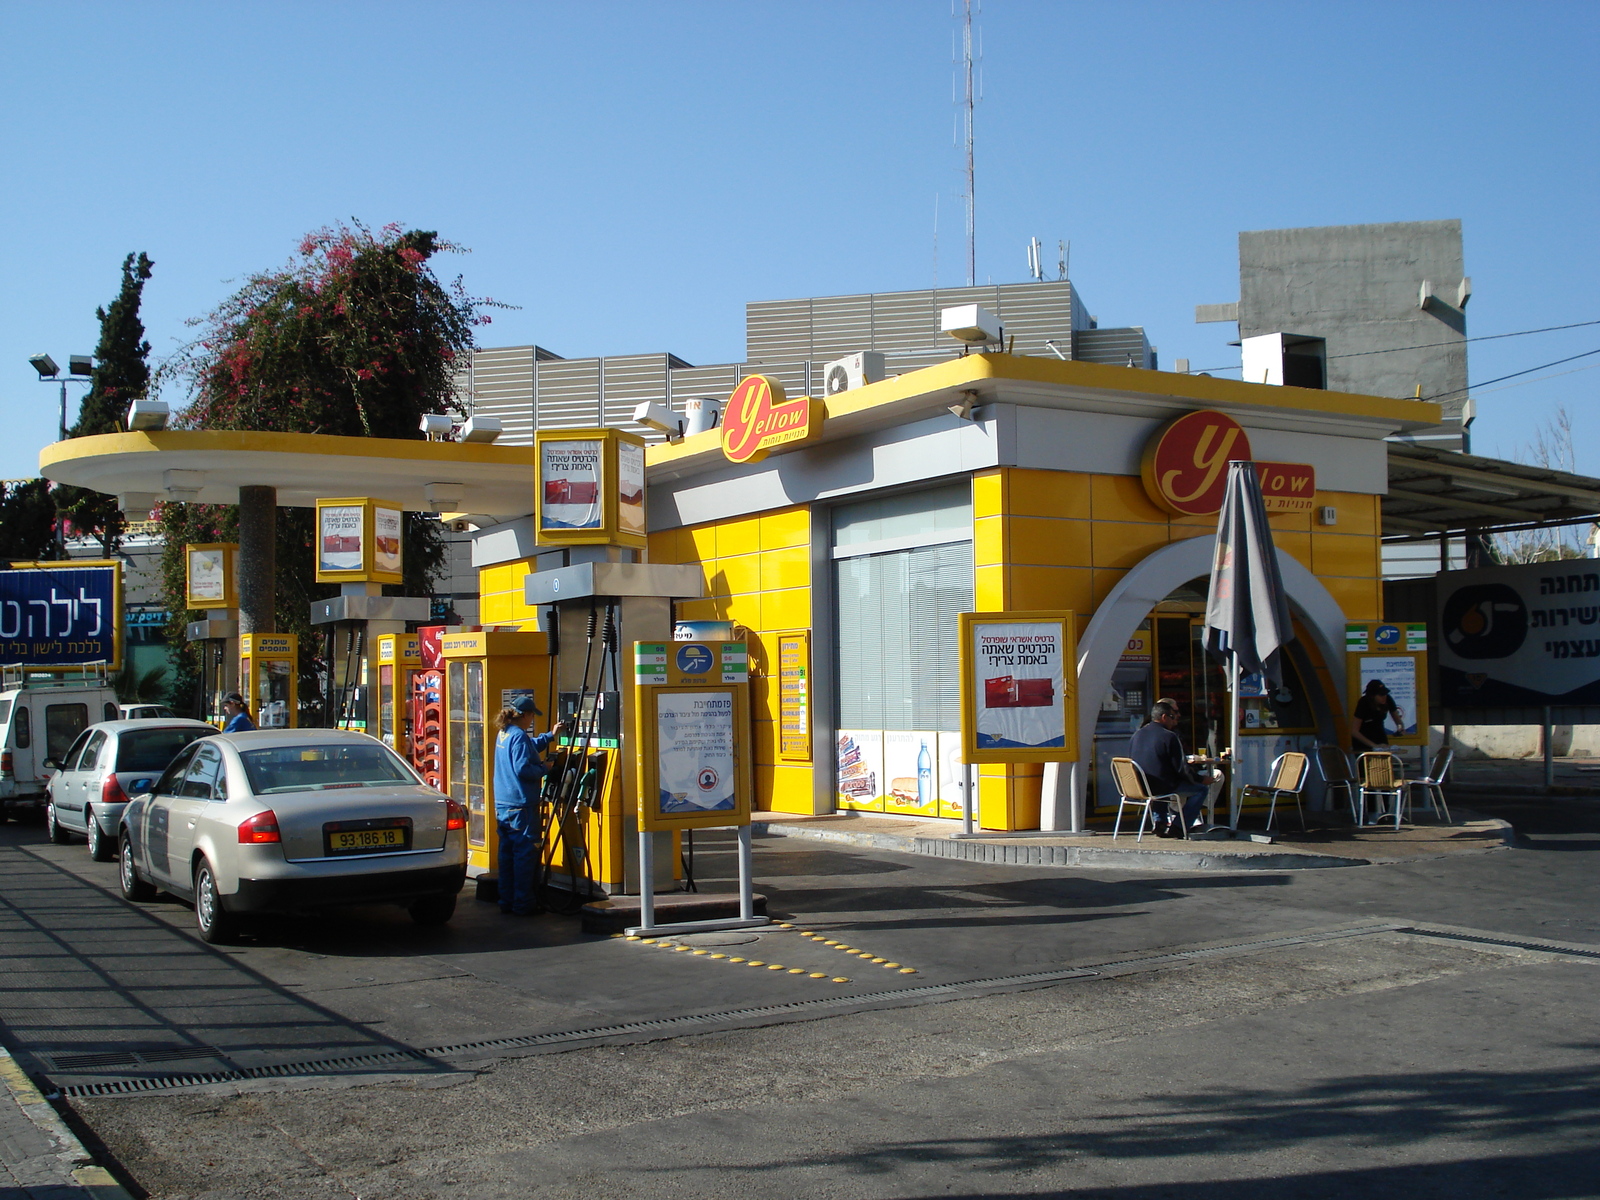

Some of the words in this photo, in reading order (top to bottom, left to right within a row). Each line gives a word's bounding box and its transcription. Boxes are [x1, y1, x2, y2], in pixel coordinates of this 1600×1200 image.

[1278, 499, 1313, 509] חנויות
[1540, 573, 1600, 595] תחנה
[1531, 606, 1600, 628] שירות
[10, 641, 28, 654] בלי
[33, 640, 62, 657] לישון
[68, 639, 101, 654] ללכת
[982, 644, 1014, 654] שאתה
[1018, 644, 1055, 654] הכרטיס
[989, 656, 1014, 667] צריך!
[1017, 655, 1048, 665] באמת
